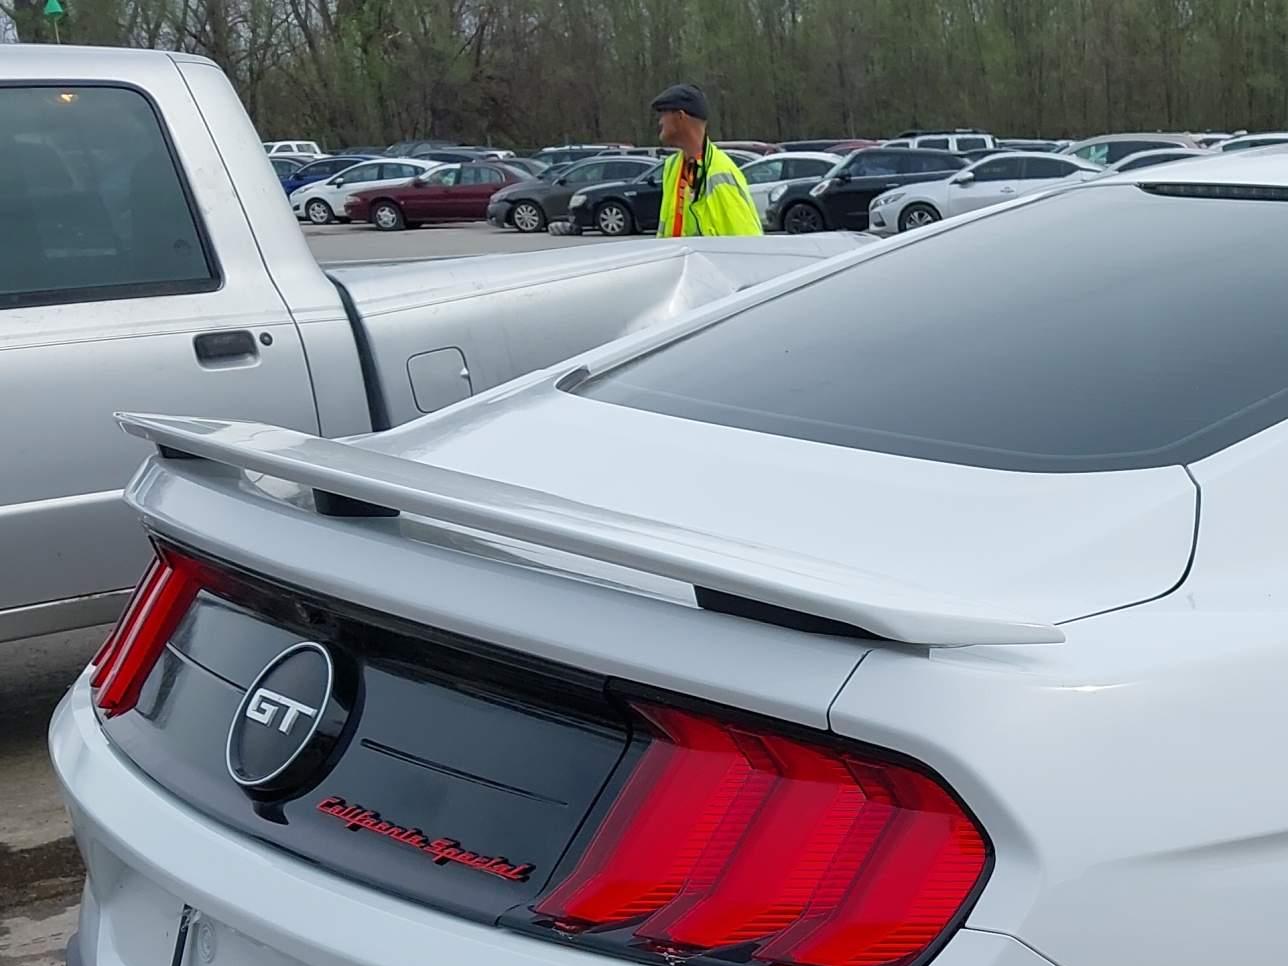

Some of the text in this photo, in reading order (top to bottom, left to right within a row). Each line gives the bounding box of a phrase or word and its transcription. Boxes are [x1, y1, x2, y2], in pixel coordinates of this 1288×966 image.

[246, 688, 318, 735] GT
[316, 797, 533, 881] California Special
